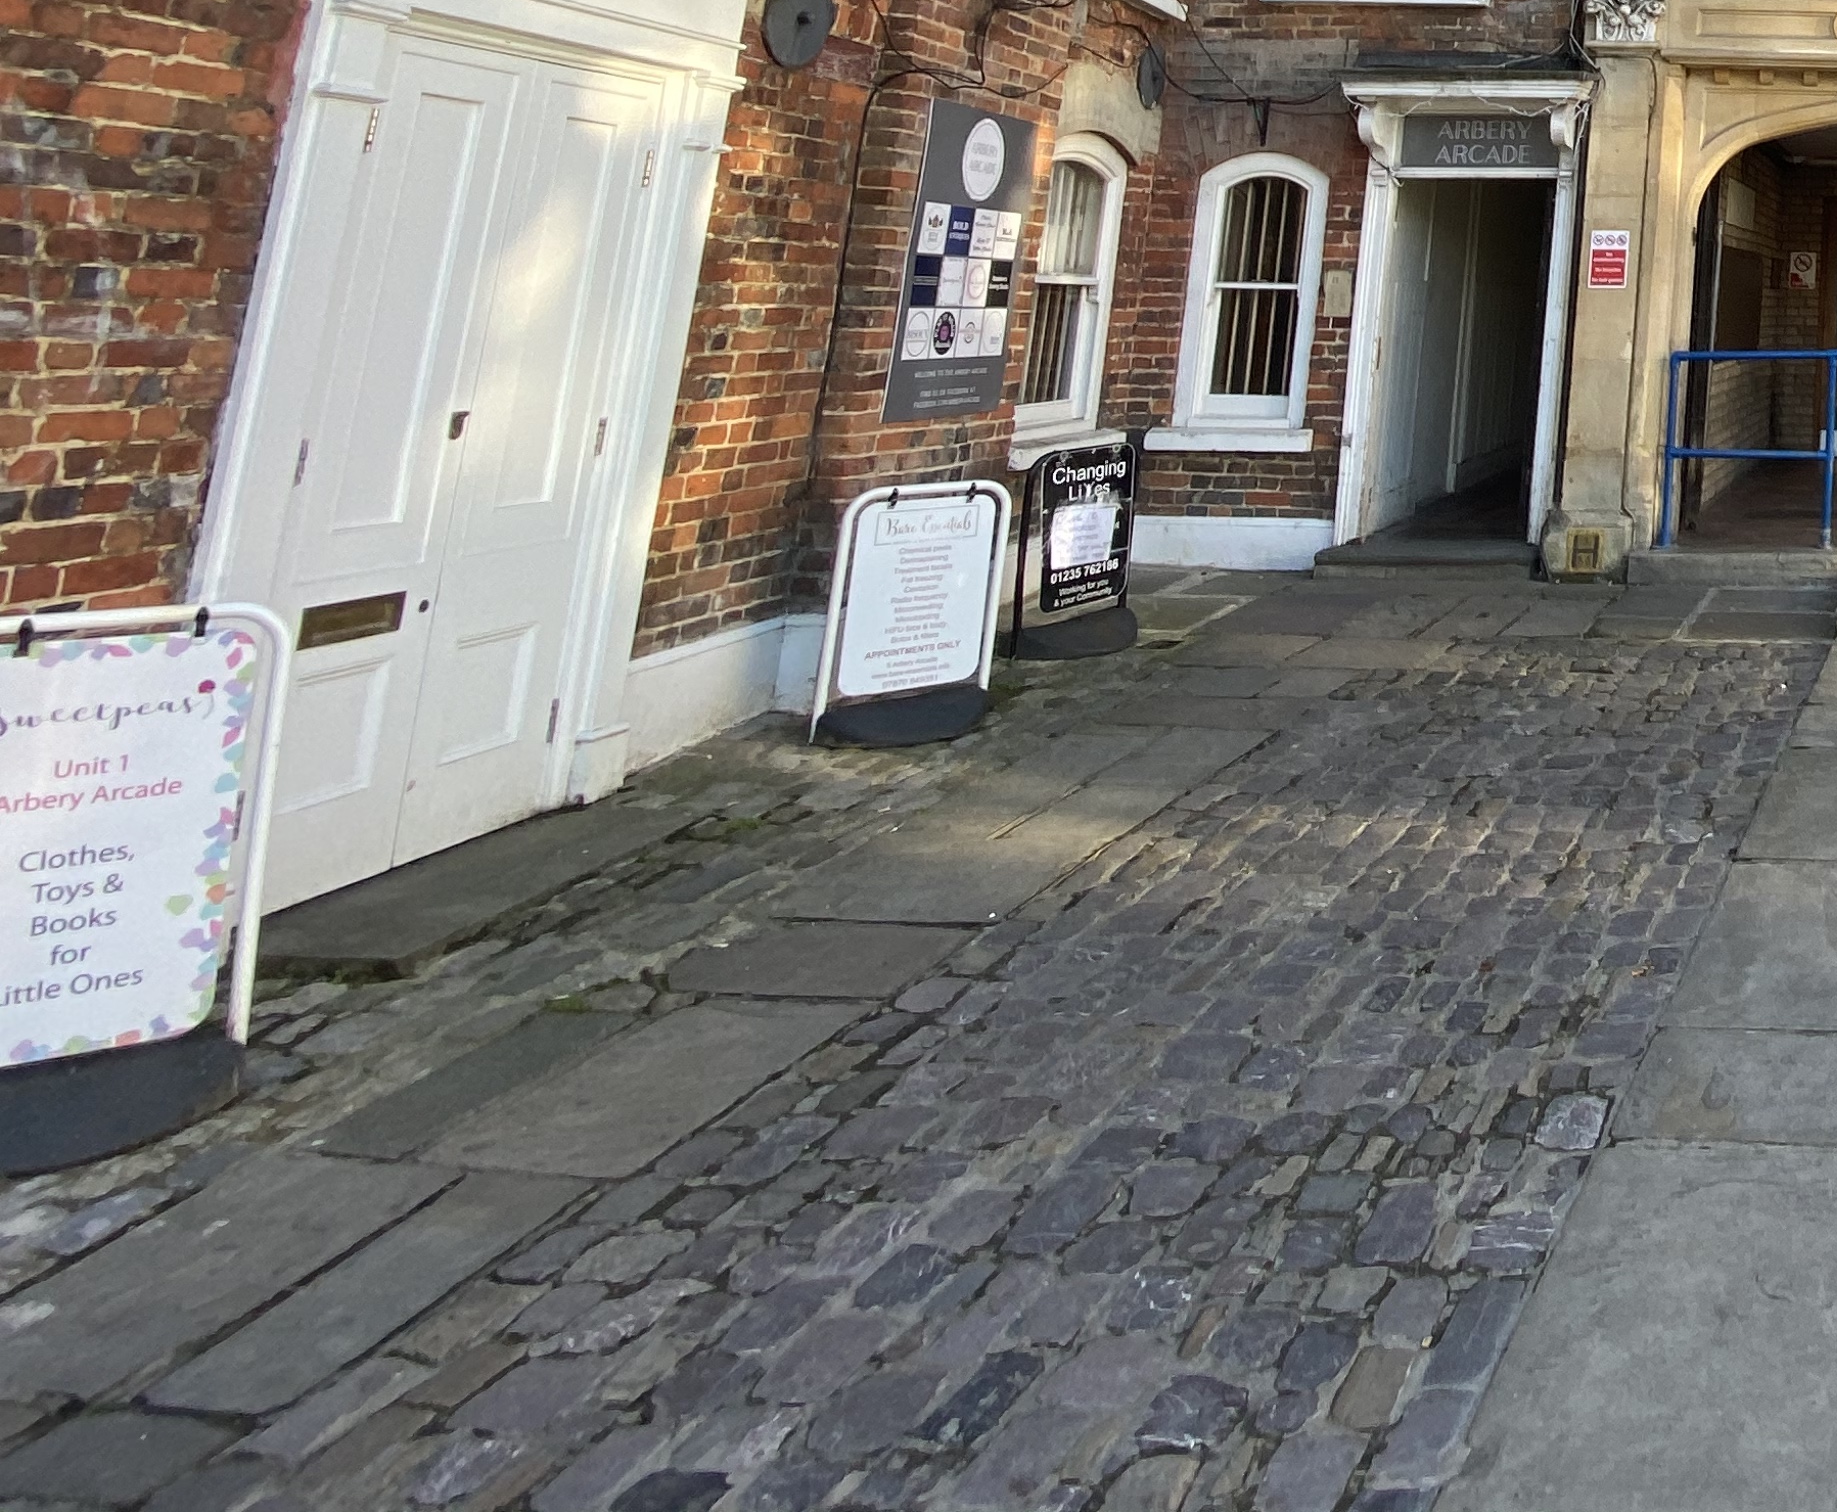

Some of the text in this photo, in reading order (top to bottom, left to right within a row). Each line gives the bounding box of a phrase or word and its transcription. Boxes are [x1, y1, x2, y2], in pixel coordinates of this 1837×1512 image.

[1437, 120, 1532, 140] ARBERY
[1434, 144, 1532, 164] ARCADE
[1052, 459, 1127, 485] Changing
[1050, 567, 1082, 585] 01235
[53, 753, 130, 779] Unit 1
[0, 776, 183, 814] Arbery Arcade
[18, 842, 135, 873] Clothes,
[31, 872, 124, 906] Toys &
[29, 907, 119, 938] Books
[49, 943, 93, 967] for
[70, 967, 144, 995] Ones
